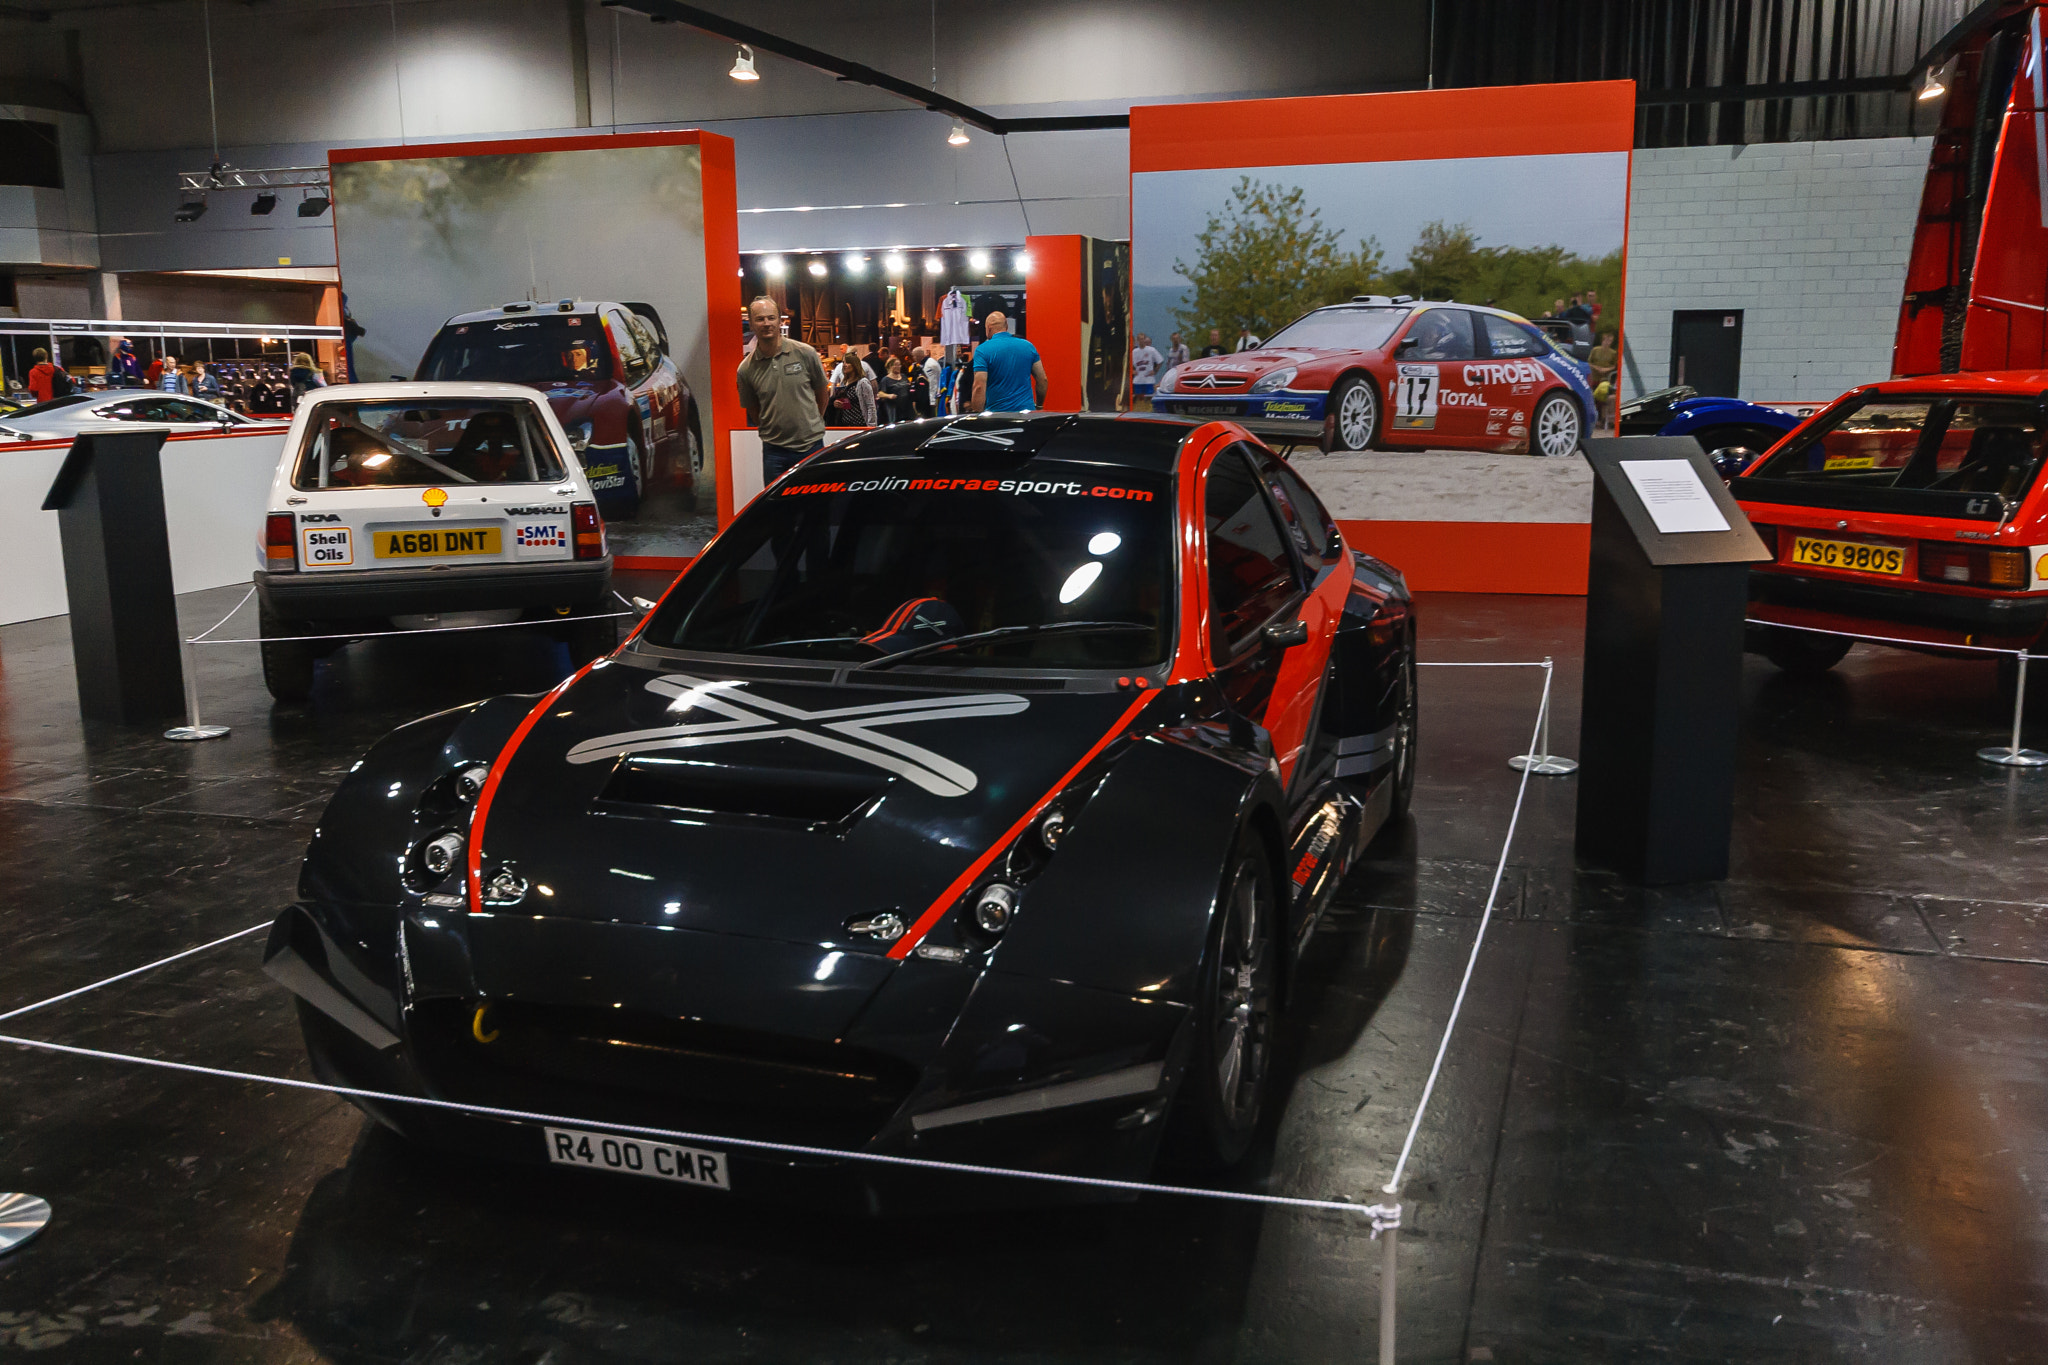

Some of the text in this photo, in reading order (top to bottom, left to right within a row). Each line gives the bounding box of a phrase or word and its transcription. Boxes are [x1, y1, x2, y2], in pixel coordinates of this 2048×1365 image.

[1193, 364, 1249, 373] TOTAL
[1406, 377, 1431, 416] 17
[1440, 389, 1488, 407] TOTAL
[1187, 404, 1239, 415] MICHELIN
[782, 476, 1153, 502] www.colinmcraesport.com
[300, 513, 342, 523] NOVA
[504, 506, 568, 516] VAUXHALL
[309, 532, 346, 545] Shell
[525, 525, 558, 539] SMT
[389, 531, 488, 555] A681 DNT
[314, 548, 344, 561] Oils
[1798, 540, 1900, 572] YSG 980S
[554, 1132, 595, 1163] R4
[653, 1147, 718, 1184] CMR
